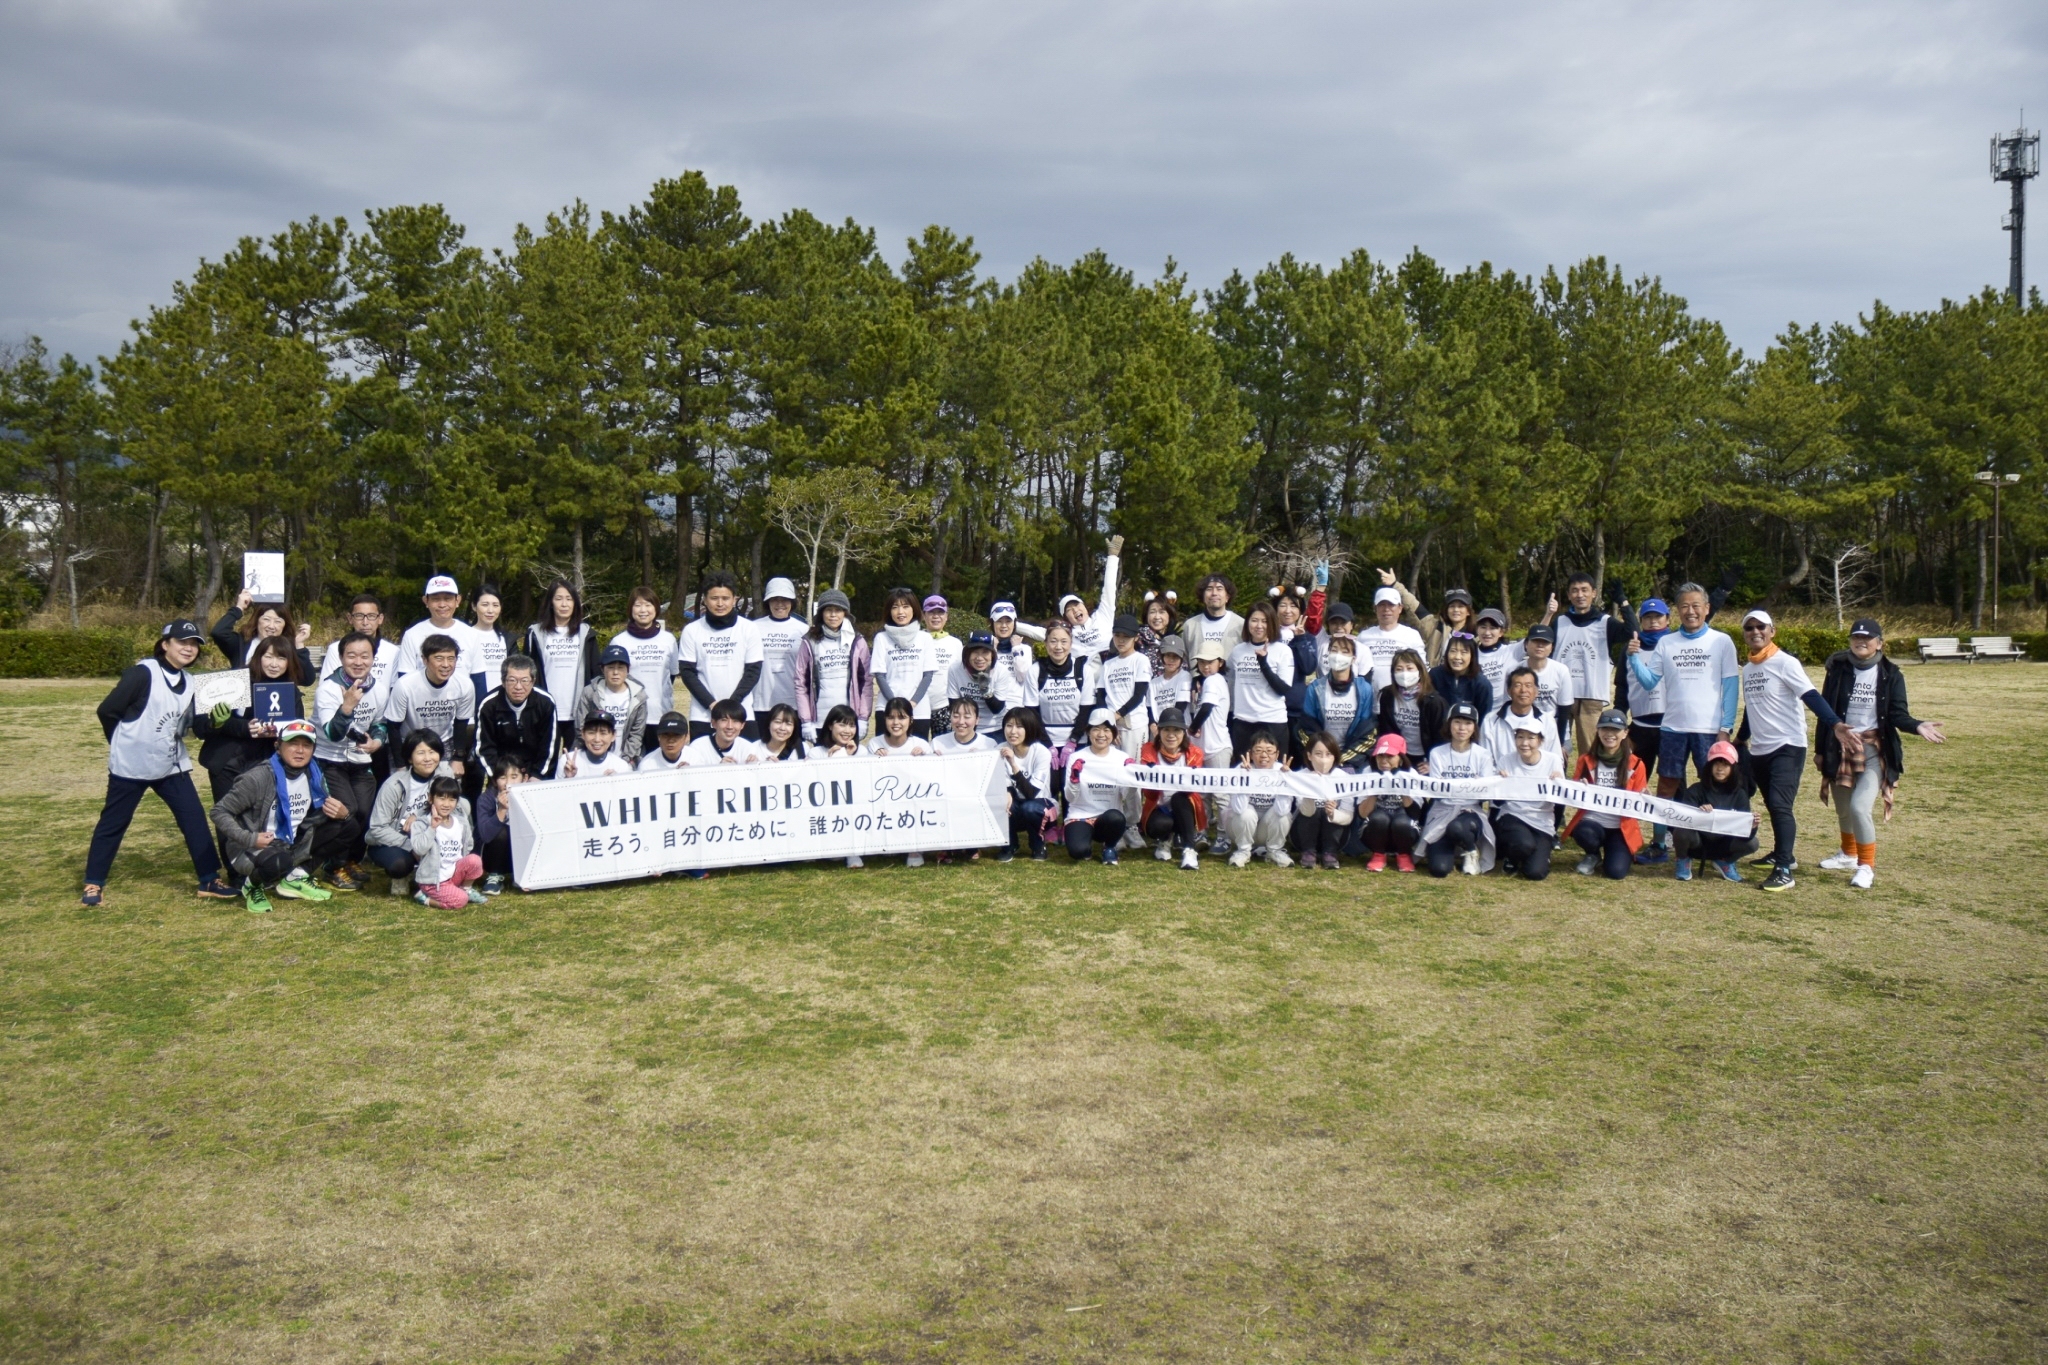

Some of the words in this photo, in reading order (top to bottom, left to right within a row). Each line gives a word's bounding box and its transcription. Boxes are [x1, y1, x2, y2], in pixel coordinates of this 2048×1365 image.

[1134, 771, 1185, 784] WHITE
[1191, 774, 1250, 787] RIBBON
[1255, 776, 1289, 788] Run
[1335, 778, 1385, 793] WHITE
[1391, 778, 1450, 792] RIBBON
[1456, 782, 1488, 794] Run
[580, 790, 702, 828] WHITE
[717, 780, 854, 814] RIBBON
[868, 775, 944, 802] Run
[1538, 783, 1586, 802] WHITE
[1593, 793, 1654, 814] RIBBON
[1660, 807, 1694, 824] Run
